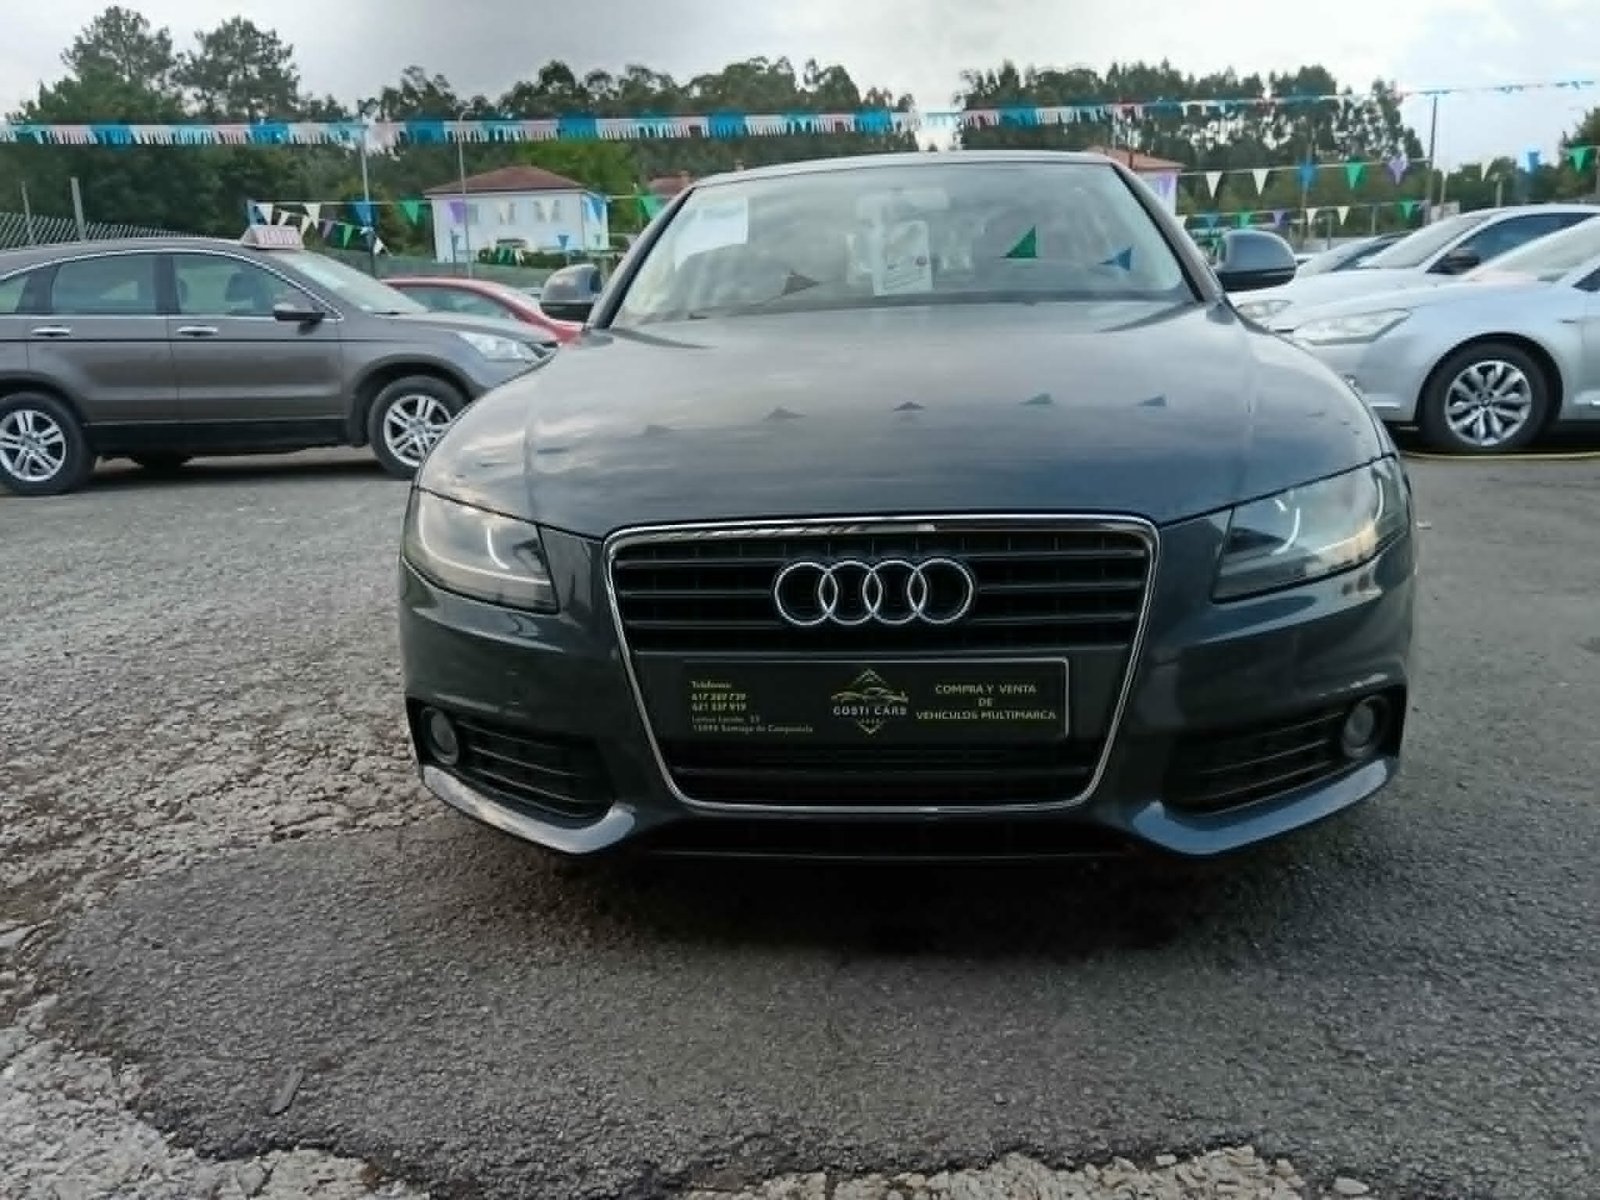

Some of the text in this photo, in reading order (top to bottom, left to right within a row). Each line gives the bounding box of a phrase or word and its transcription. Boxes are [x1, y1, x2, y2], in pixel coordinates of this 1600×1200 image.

[935, 684, 1037, 695] COMPRA Y VENTA
[977, 697, 994, 707] DE
[874, 705, 907, 716] CARS
[980, 710, 1057, 720] MULTIMARCA
